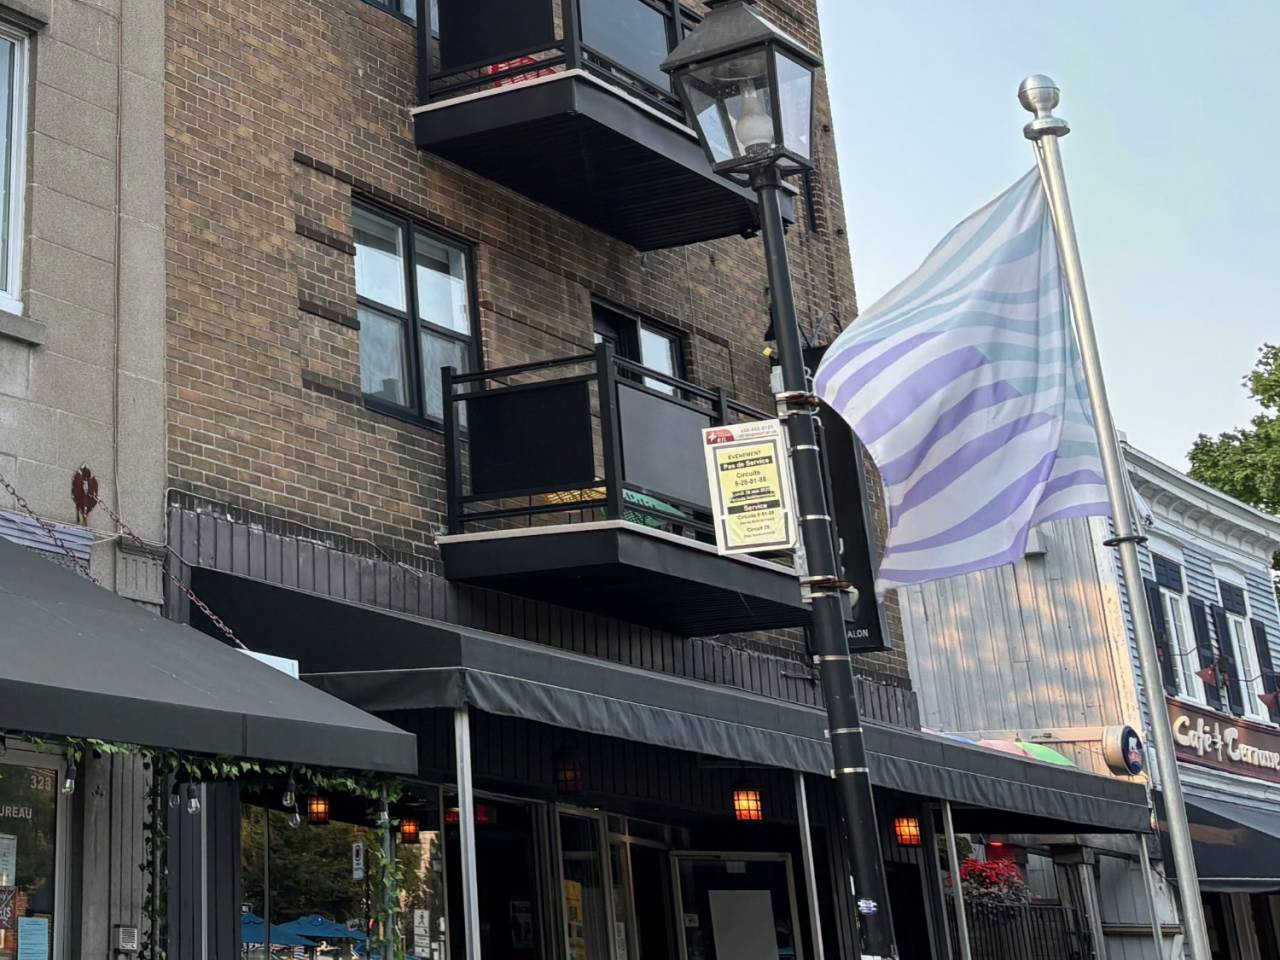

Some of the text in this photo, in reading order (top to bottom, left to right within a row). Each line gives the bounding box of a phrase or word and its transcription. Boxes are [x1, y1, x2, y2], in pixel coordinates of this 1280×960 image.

[745, 458, 770, 467] Service
[736, 470, 761, 478] Circuits
[743, 503, 768, 512] Service
[847, 629, 869, 639] ALON
[1173, 715, 1212, 756] Café
